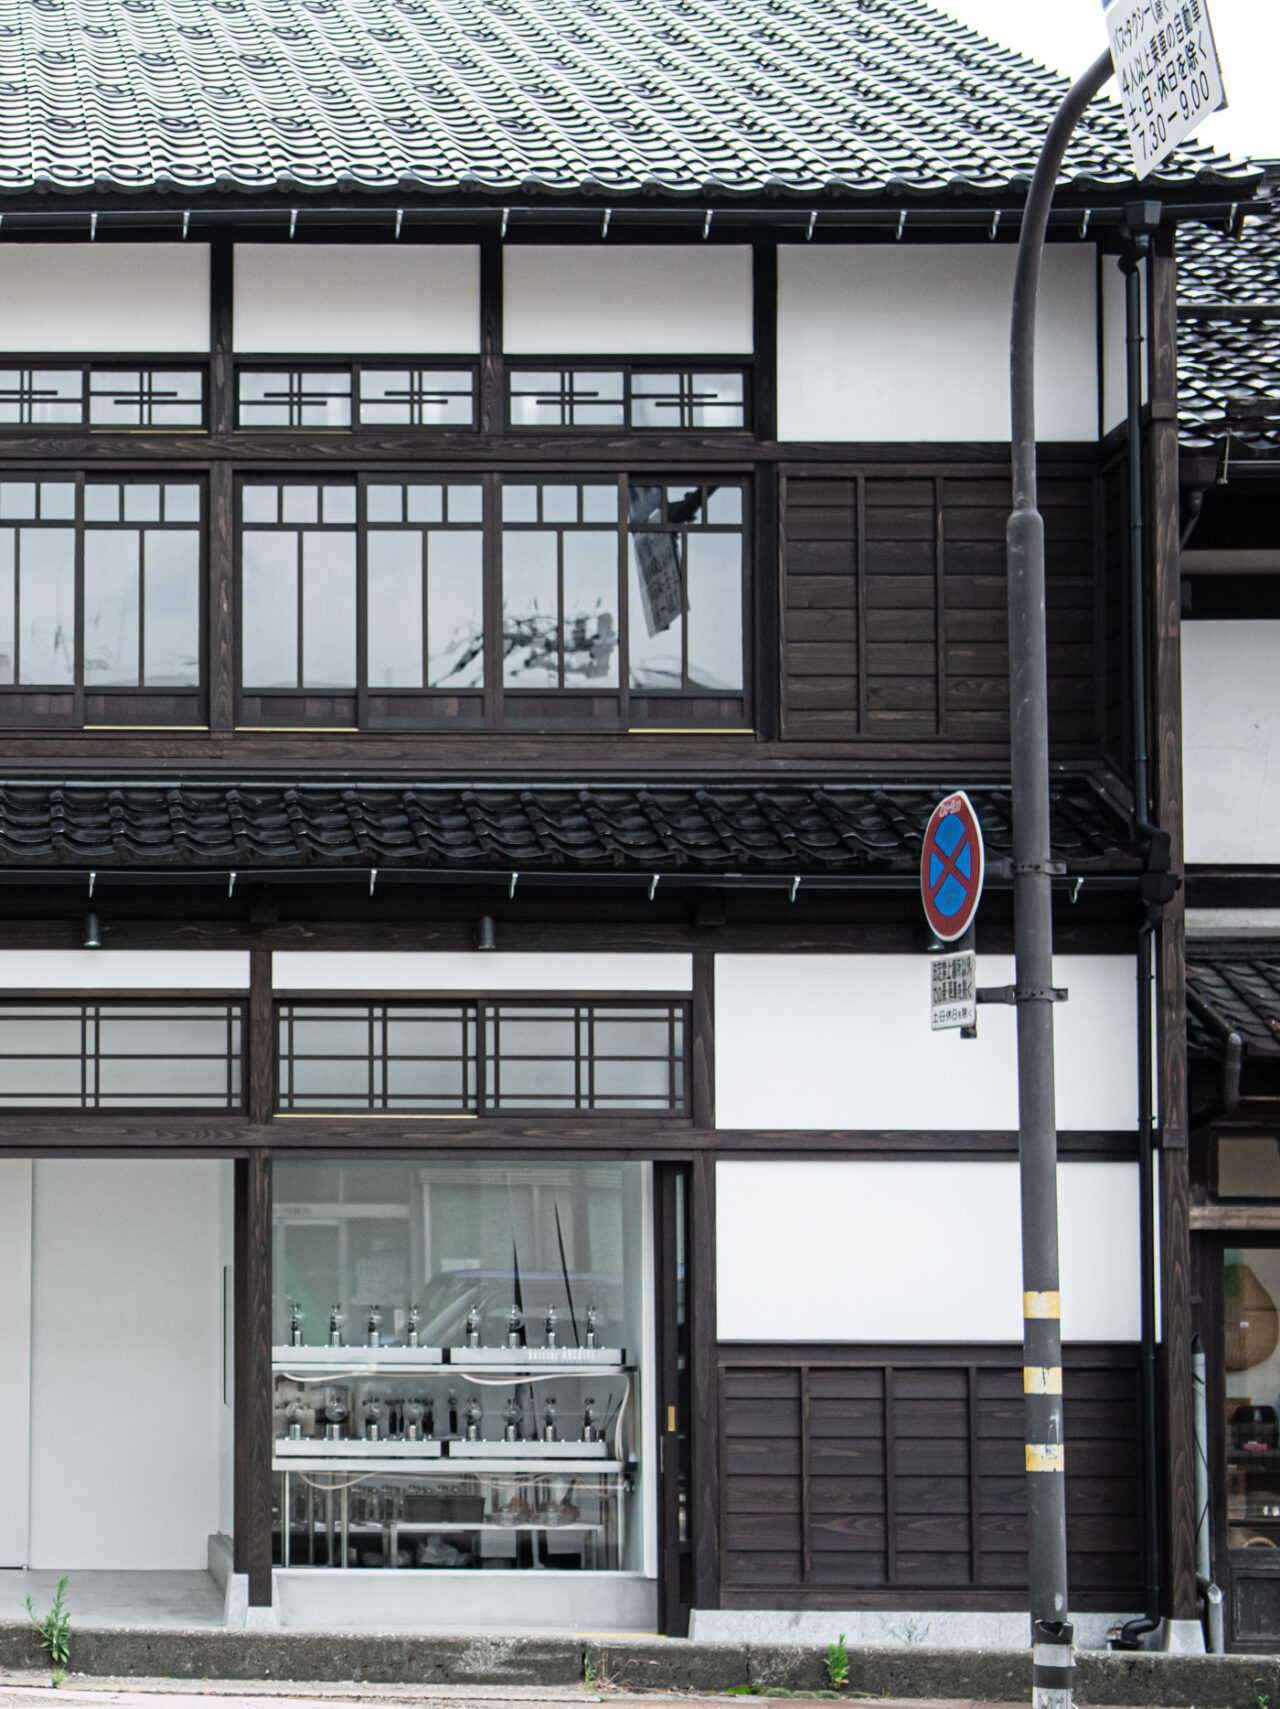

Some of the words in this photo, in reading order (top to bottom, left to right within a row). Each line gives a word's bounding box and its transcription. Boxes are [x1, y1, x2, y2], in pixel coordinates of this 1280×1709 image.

[1129, 30, 1207, 131] 土・日・休日を除く
